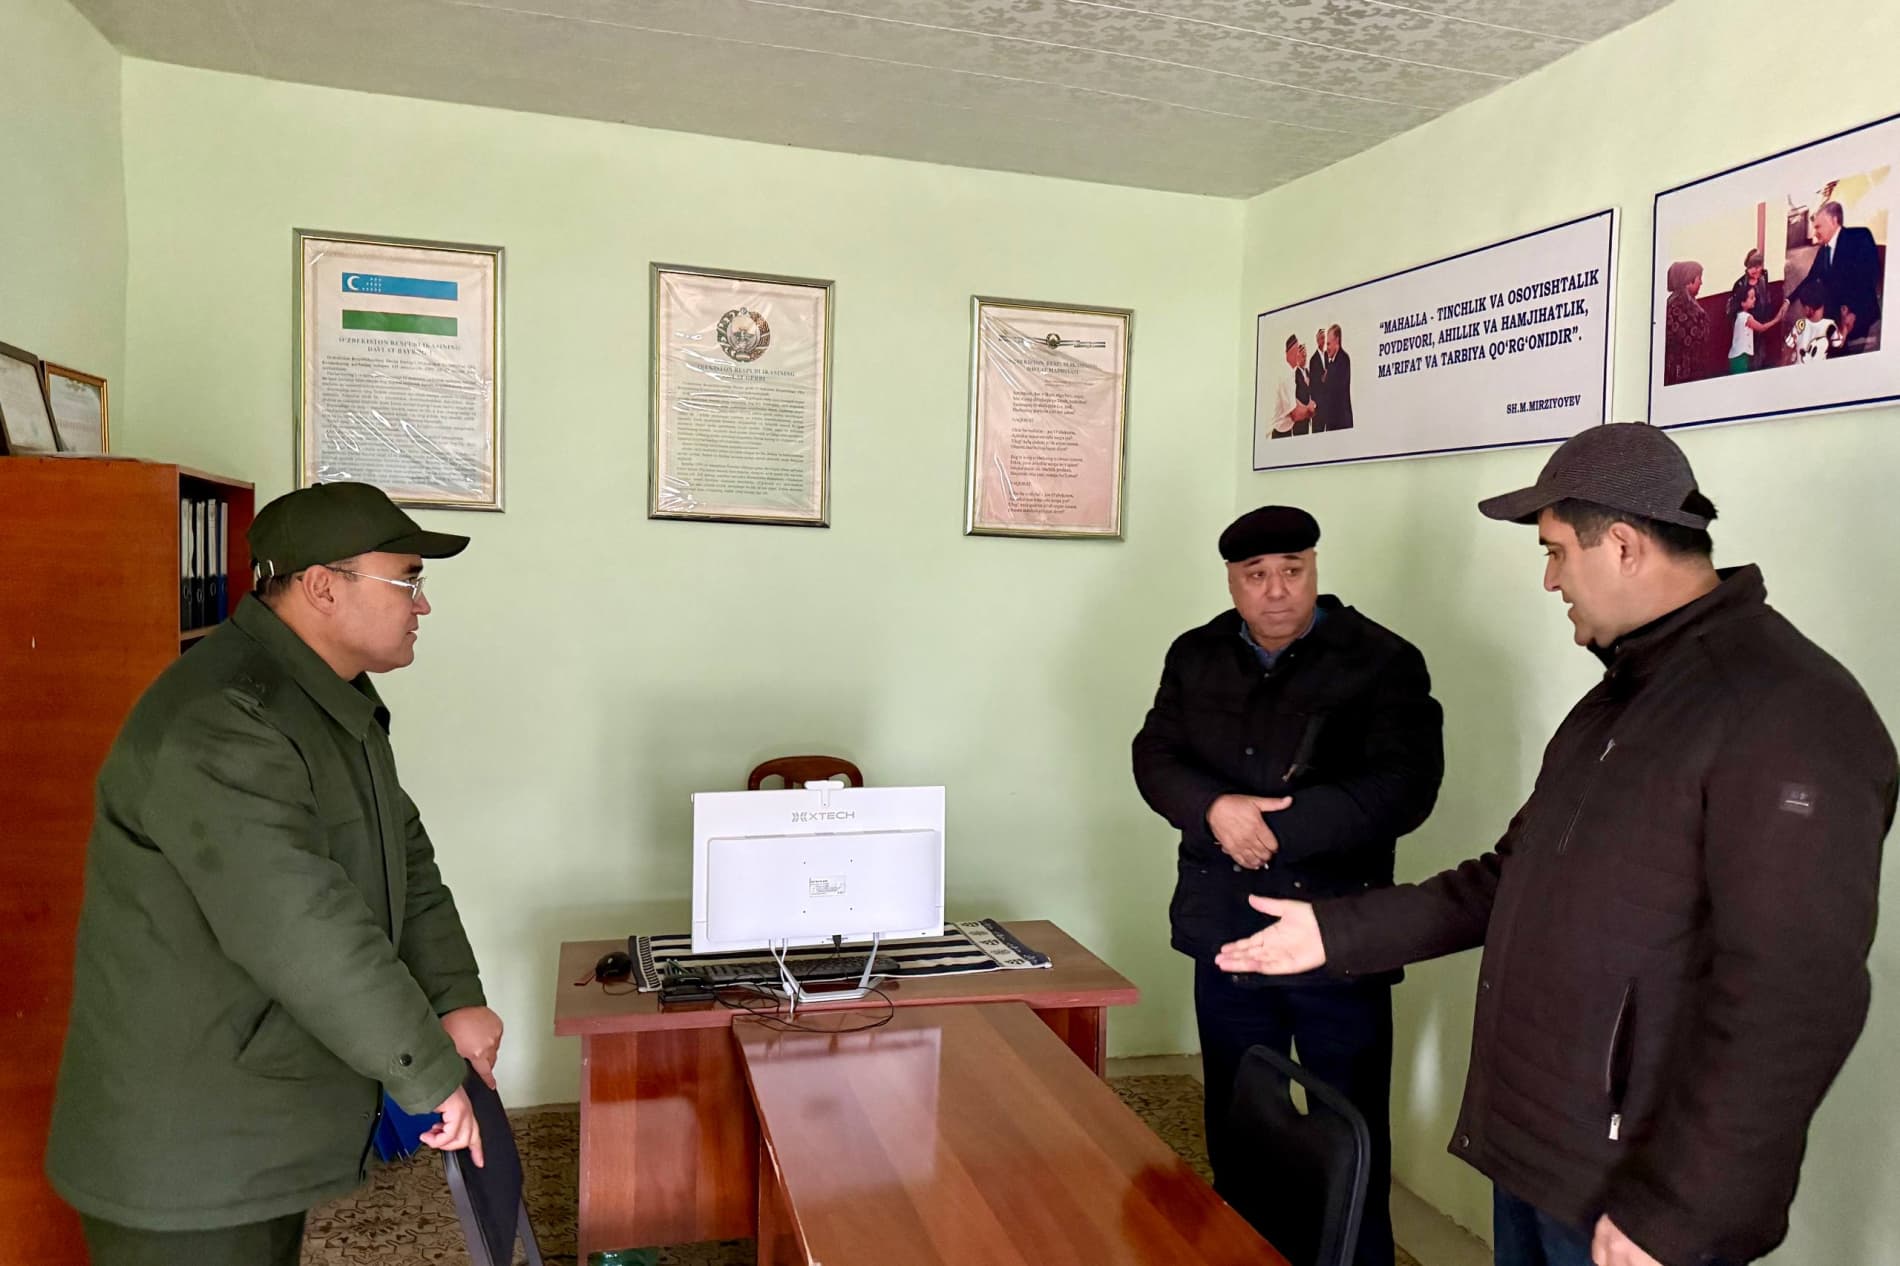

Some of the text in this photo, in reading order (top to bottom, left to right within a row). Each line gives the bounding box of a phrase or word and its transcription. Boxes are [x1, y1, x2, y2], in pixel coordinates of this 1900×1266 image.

[1379, 312, 1427, 334] “MAHALLA
[1437, 297, 1487, 321] TINCHLIK
[1490, 293, 1505, 310] VA
[1508, 269, 1600, 305] OSOYISHTALIK
[1379, 298, 1589, 357] POYDEVORI, AHILLIK VA HAMJIHATLIK,
[1378, 357, 1423, 378] MA'RIFAT
[1425, 354, 1438, 369] VA
[1441, 345, 1486, 365] TARBIYA
[1506, 395, 1581, 415] SH.M.MIRZIYOYEV
[808, 810, 855, 821] XTECH
